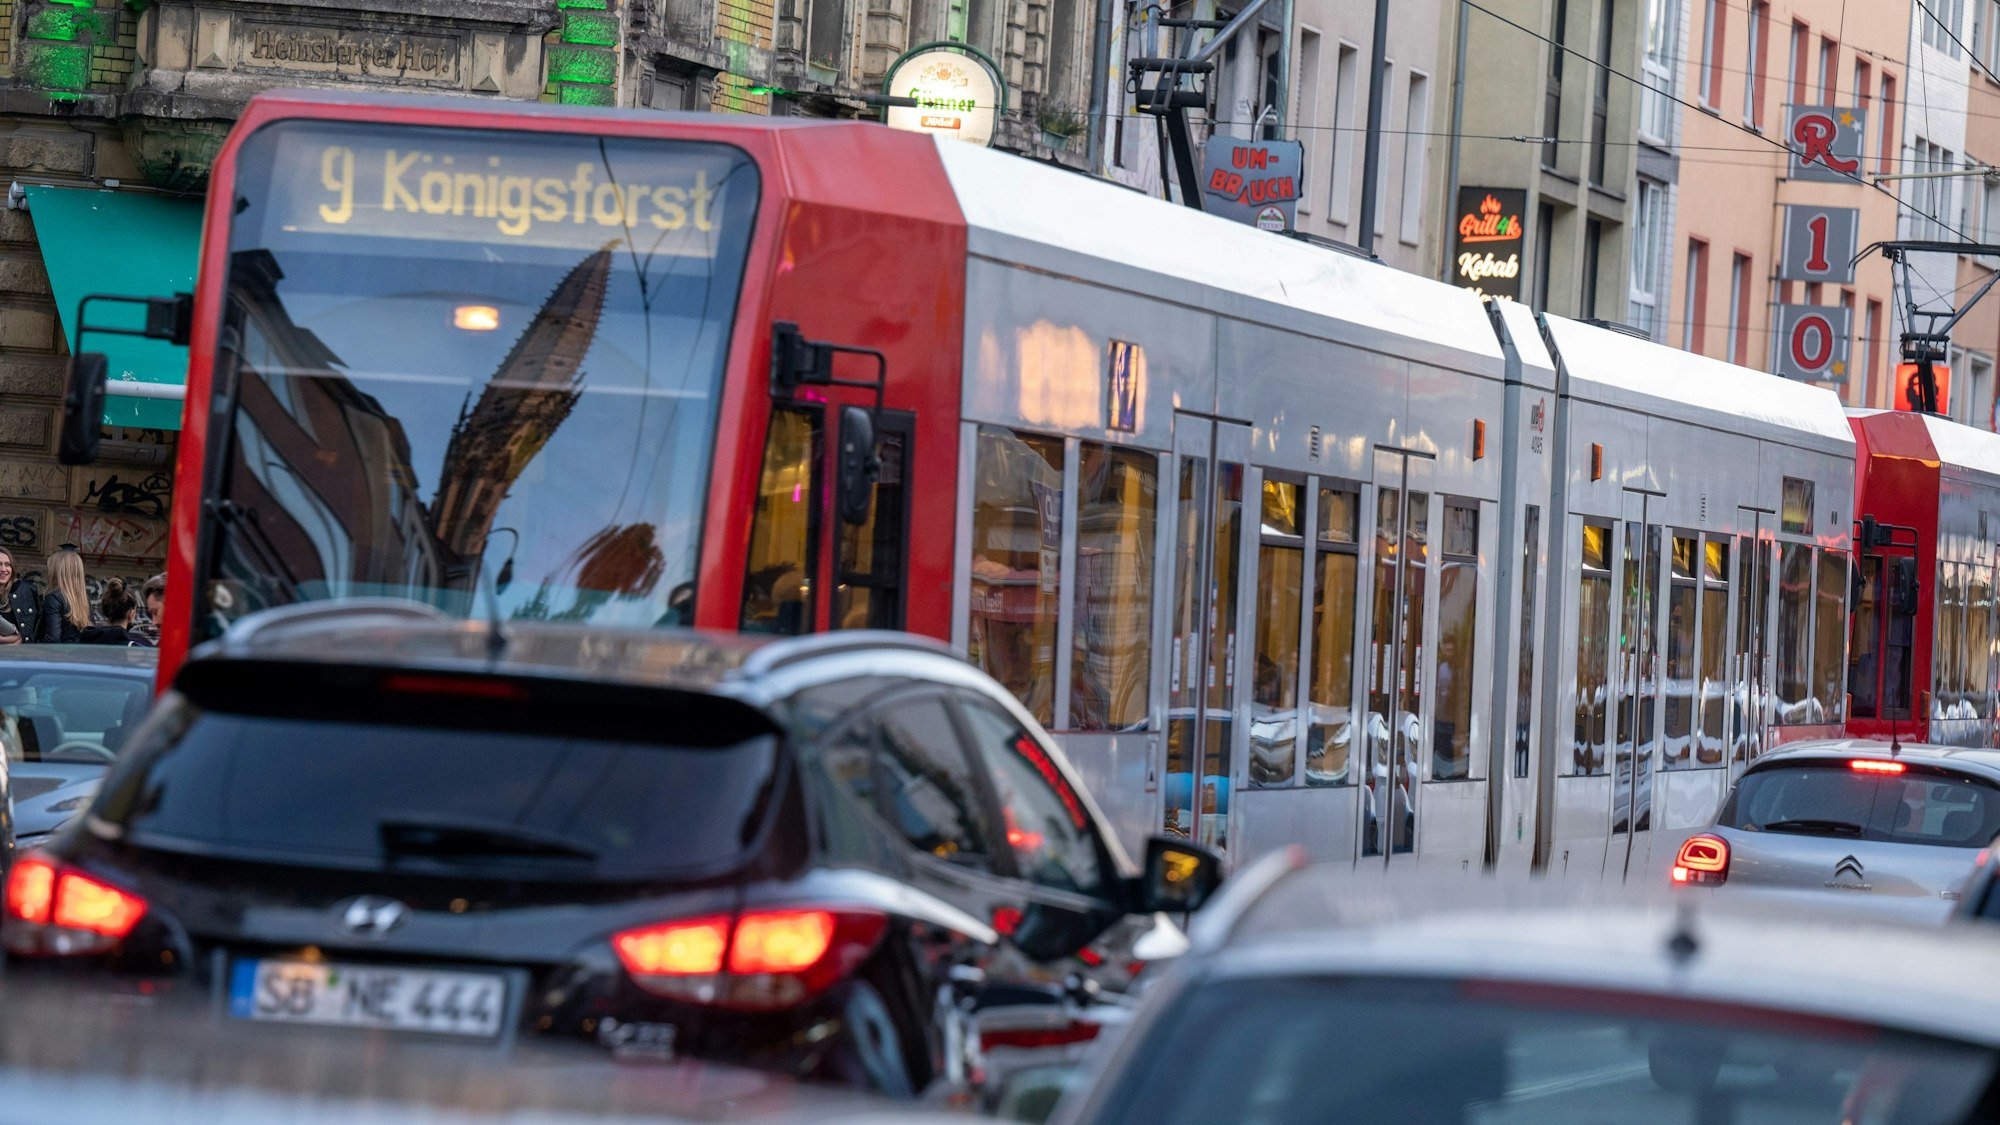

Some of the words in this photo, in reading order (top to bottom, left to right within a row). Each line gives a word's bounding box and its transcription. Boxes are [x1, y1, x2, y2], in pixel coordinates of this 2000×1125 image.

[1231, 146, 1279, 170] UM-
[319, 146, 355, 224] 9
[382, 149, 713, 236] Königsforst
[1459, 213, 1521, 238] Grill4k
[1458, 252, 1519, 282] Kebab
[410, 980, 492, 1025] 444
